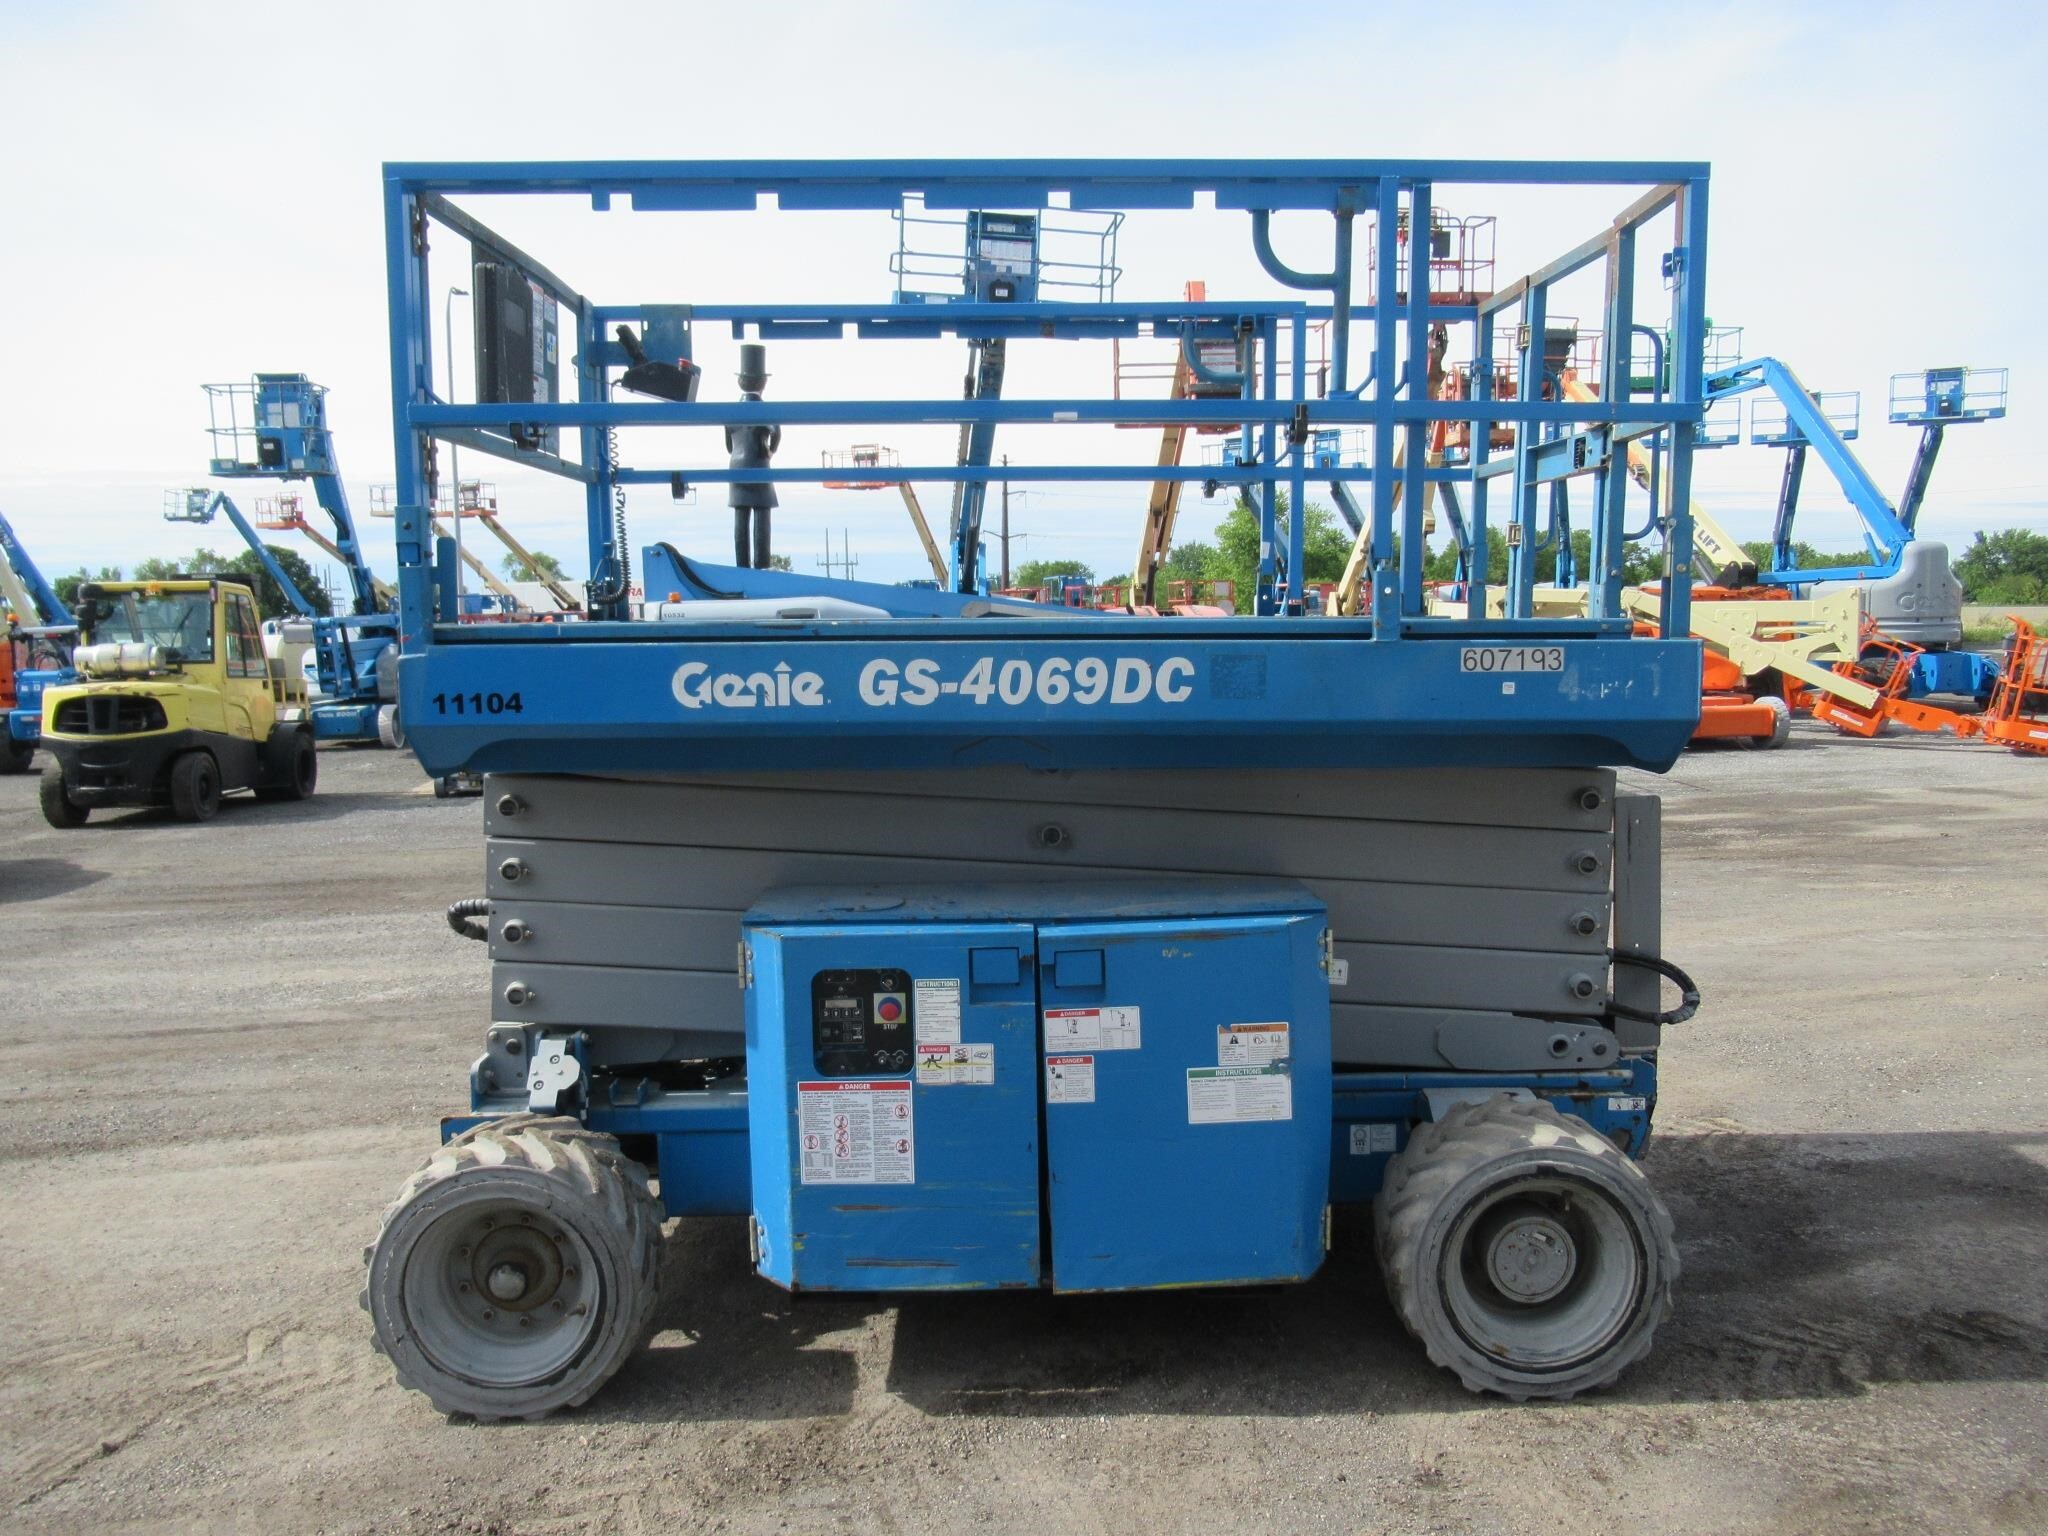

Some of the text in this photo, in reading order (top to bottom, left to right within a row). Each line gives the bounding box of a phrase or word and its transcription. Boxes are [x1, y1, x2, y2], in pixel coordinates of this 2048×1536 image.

[1697, 529, 1721, 554] LIFT
[1463, 648, 1562, 671] 607193
[671, 656, 1195, 709] Genie GS-4069DC
[432, 692, 524, 715] 11104
[917, 980, 958, 988] INSTRUCTIONS
[882, 1023, 899, 1031] STOP
[1243, 1025, 1270, 1033] WARNING
[1215, 1067, 1262, 1077] INSTRUCTIONS
